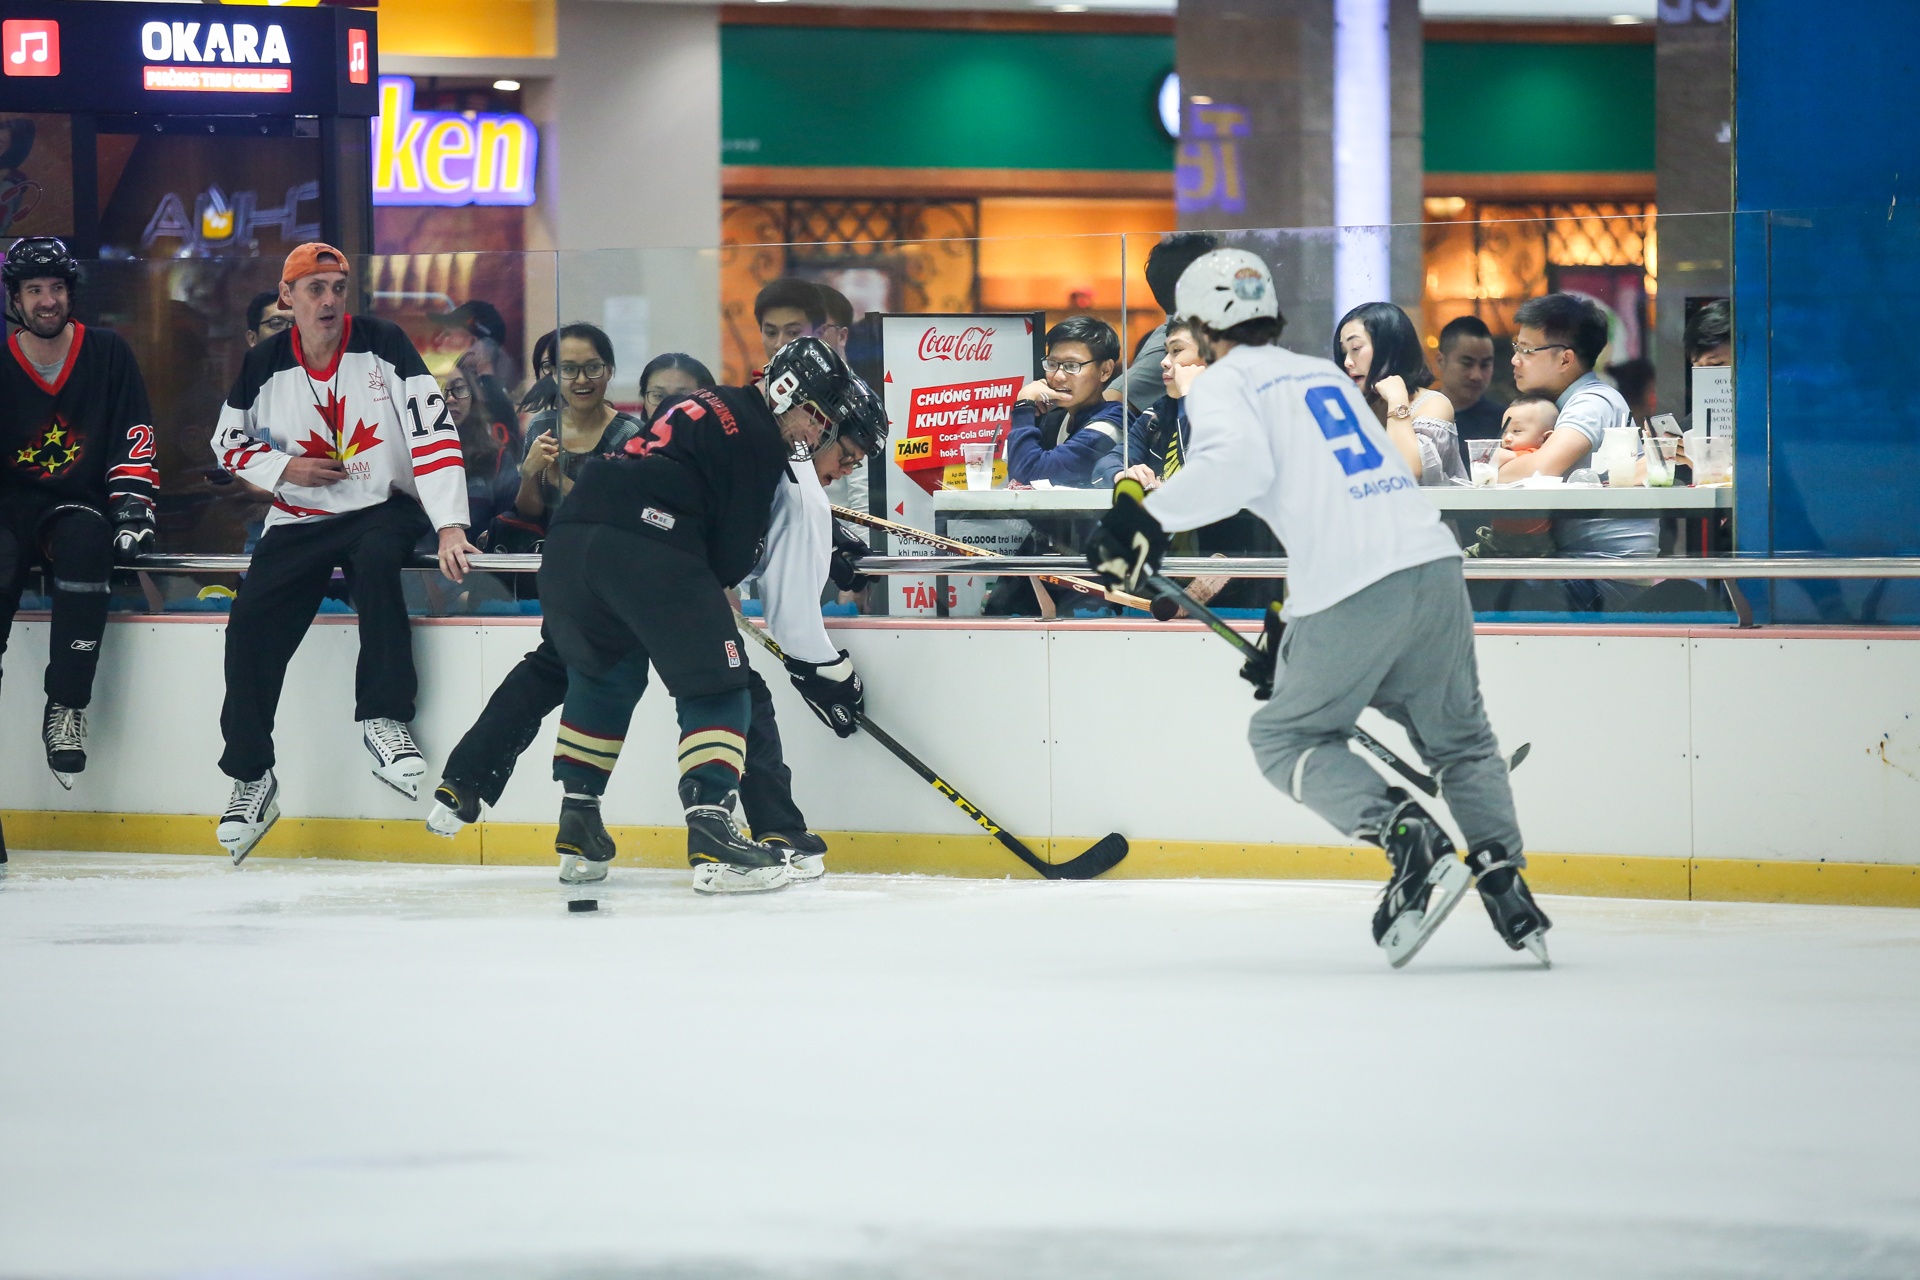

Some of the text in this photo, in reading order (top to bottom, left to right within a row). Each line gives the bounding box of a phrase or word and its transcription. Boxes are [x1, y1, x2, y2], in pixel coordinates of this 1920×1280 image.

[142, 21, 291, 63] OKARA
[375, 85, 525, 193] ken
[918, 327, 998, 361] Coca-Cola
[917, 383, 1012, 406] CHƯƠNG TRÌNH
[405, 393, 456, 439] 12
[915, 403, 1011, 428] KHUYẾN MÃI
[939, 428, 1004, 442] Coca-Cola Gingr
[1305, 386, 1384, 477] 9
[898, 441, 929, 457] TẶNG
[940, 448, 958, 458] hoặc
[1350, 475, 1416, 500] SAIGON
[962, 535, 996, 544] 60.000đ
[931, 777, 1001, 836] CCM
